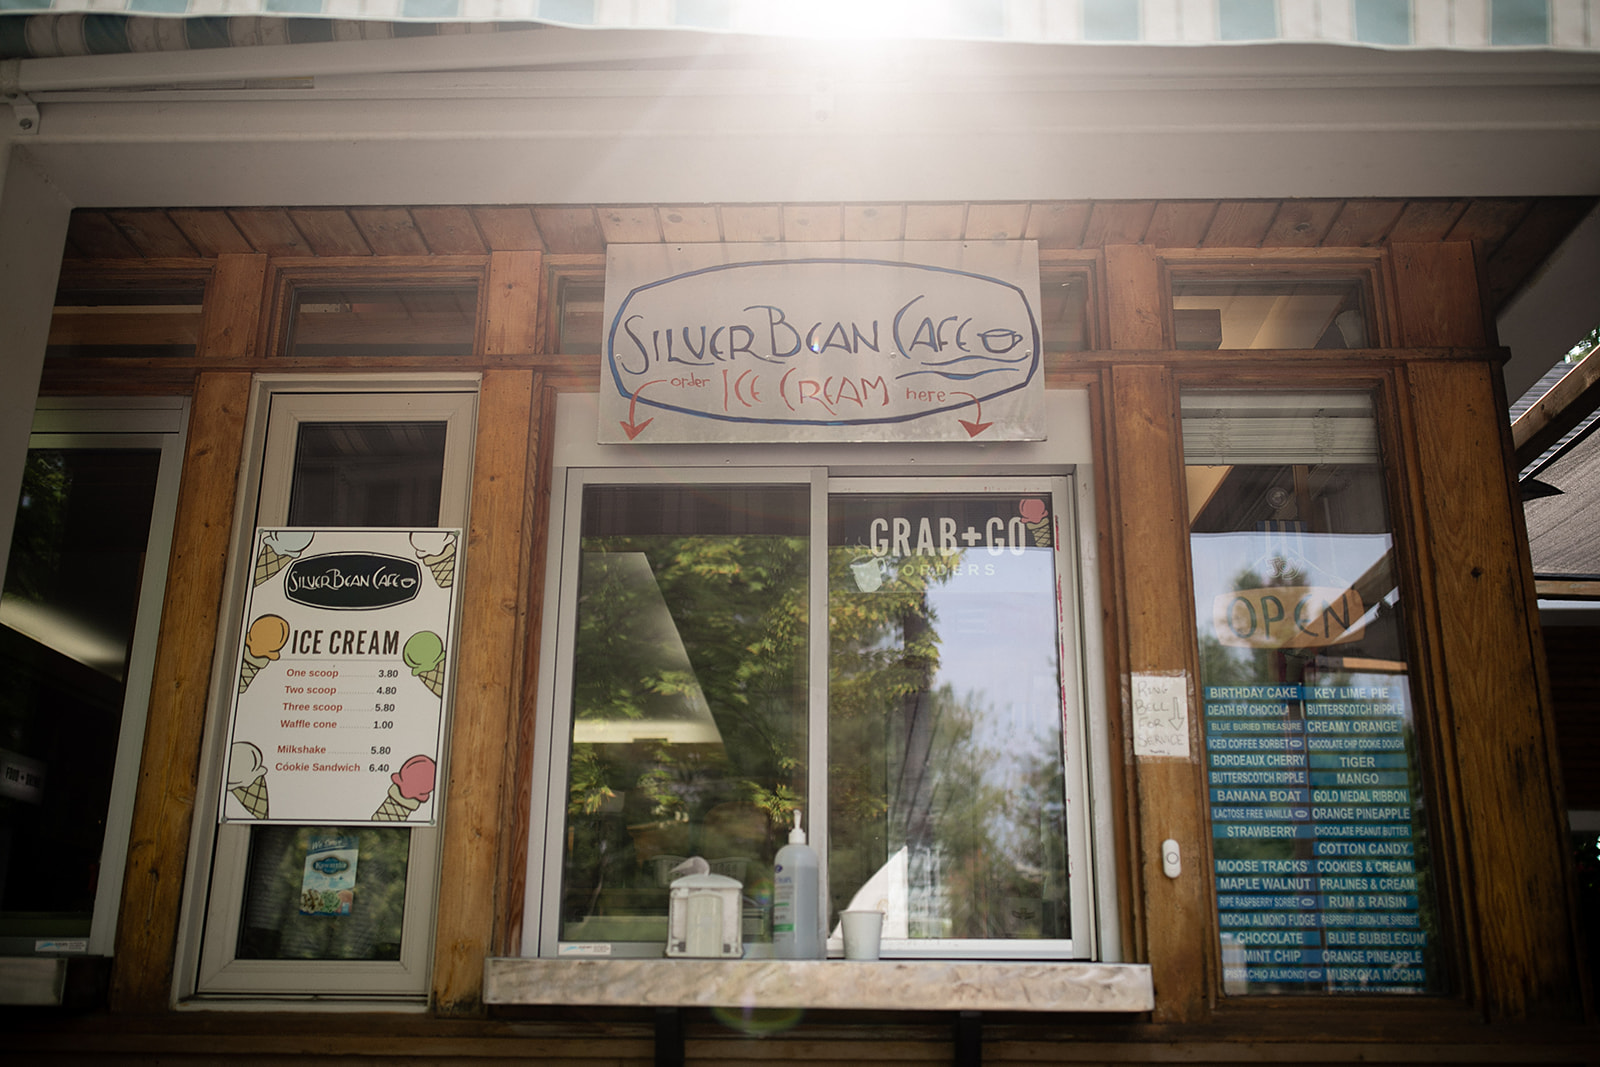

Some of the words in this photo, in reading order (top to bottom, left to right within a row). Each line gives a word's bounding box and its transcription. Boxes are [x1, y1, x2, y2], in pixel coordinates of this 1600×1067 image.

[622, 315, 785, 374] SILVER
[744, 305, 880, 358] BEAN
[893, 295, 973, 359] CAFE
[670, 373, 710, 389] order
[722, 369, 763, 411] ICE
[780, 368, 890, 415] CREAM
[906, 387, 946, 402] here
[903, 564, 995, 576] ORDERS
[289, 571, 338, 592] SILVER
[325, 568, 370, 590] BEAN
[372, 566, 400, 589] CAFE
[1226, 594, 1350, 640] OPEN
[291, 630, 323, 654] ICE
[329, 630, 399, 655] CREAM
[287, 669, 306, 677] One
[309, 670, 338, 679] scoop
[378, 670, 398, 678] 3.80
[285, 686, 304, 694] Two
[307, 687, 336, 696] scoop
[376, 687, 397, 695] 4.80
[1210, 688, 1264, 699] BIRTHDAY
[1267, 687, 1297, 698] CAKE
[1314, 688, 1336, 698] KEY
[1341, 688, 1366, 698] LIME
[1371, 688, 1389, 698] PIE
[283, 703, 309, 711] Three
[312, 704, 342, 713] scoop
[375, 704, 395, 712] 5.80
[1135, 699, 1169, 715] BELL
[1208, 705, 1236, 715] DEATH
[1237, 705, 1249, 715] BY
[1307, 705, 1372, 715] BUTTERSCOTCH
[1374, 705, 1403, 715] RIPPLE
[281, 720, 311, 729] Waffle
[313, 721, 337, 729] cone
[374, 721, 393, 729] 1.00
[1139, 716, 1164, 729] FOR
[1263, 723, 1302, 731] TREASURE
[1308, 722, 1350, 732] CREAMY
[1353, 722, 1398, 732] ORANGE
[1209, 739, 1227, 749] ICED
[1228, 739, 1258, 749] COFFEE
[1259, 739, 1288, 749] SORBET
[1309, 740, 1343, 749] CHOCOLATE
[277, 745, 326, 754] Milkshake
[371, 746, 391, 754] 5.80
[1213, 755, 1264, 765] BORDEAUX
[1267, 755, 1305, 765] CHERRY
[1339, 757, 1375, 767] TIGER
[275, 762, 310, 771] Cookie
[312, 763, 360, 772] Sandwich
[369, 764, 389, 772] 6.40
[1212, 773, 1275, 783] BUTTERSCOTCH
[1276, 773, 1304, 783] RIPPLE
[1337, 773, 1379, 784] MANGO
[1217, 791, 1267, 801] BANANA
[1270, 791, 1302, 801] BOAT
[1314, 791, 1338, 801] GOLD
[1341, 791, 1371, 801] MEDAL
[1372, 791, 1407, 801] RIBBON
[1215, 809, 1246, 818] LACTOSE
[1247, 809, 1264, 818] FREE
[1265, 809, 1293, 818] VANILLA
[1312, 808, 1353, 819] ORANGE
[1356, 808, 1410, 819] PINEAPPLE
[1227, 826, 1297, 837] STRAWBERRY
[1314, 827, 1354, 836] CHOCOLATE
[1355, 827, 1381, 836] PEANUT
[1382, 827, 1409, 836] BUTTER
[1319, 844, 1365, 854] COTTON
[1369, 844, 1409, 854] CANDY
[1218, 861, 1258, 872] MOOSE
[1261, 861, 1308, 872] TRACKS
[1317, 862, 1363, 872] COOKIES
[1366, 862, 1373, 872] &
[1375, 862, 1412, 872] CREAM
[1220, 878, 1259, 890] MAPLE
[1262, 878, 1311, 890] WALNUT
[1320, 879, 1368, 890] PRALINES
[1370, 879, 1377, 890] &
[1380, 879, 1415, 890] CREAM
[1329, 897, 1356, 908] RUM
[1359, 897, 1366, 907] &
[1368, 897, 1407, 907] RAISIN
[1221, 914, 1249, 925] MOCHA
[1252, 914, 1286, 925] ALMOND
[1288, 914, 1316, 925] FUDGE
[1237, 932, 1304, 944] CHOCOLATE
[1328, 933, 1356, 944] BLUE
[1359, 933, 1426, 944] BUBBLEGUM
[1243, 951, 1273, 962] MINT
[1275, 951, 1301, 962] CHIP
[1322, 951, 1365, 962] ORANGE
[1367, 952, 1422, 962] PINEAPPLE
[1327, 969, 1381, 981] MUSKOKA
[1383, 970, 1423, 981] MOCHA
